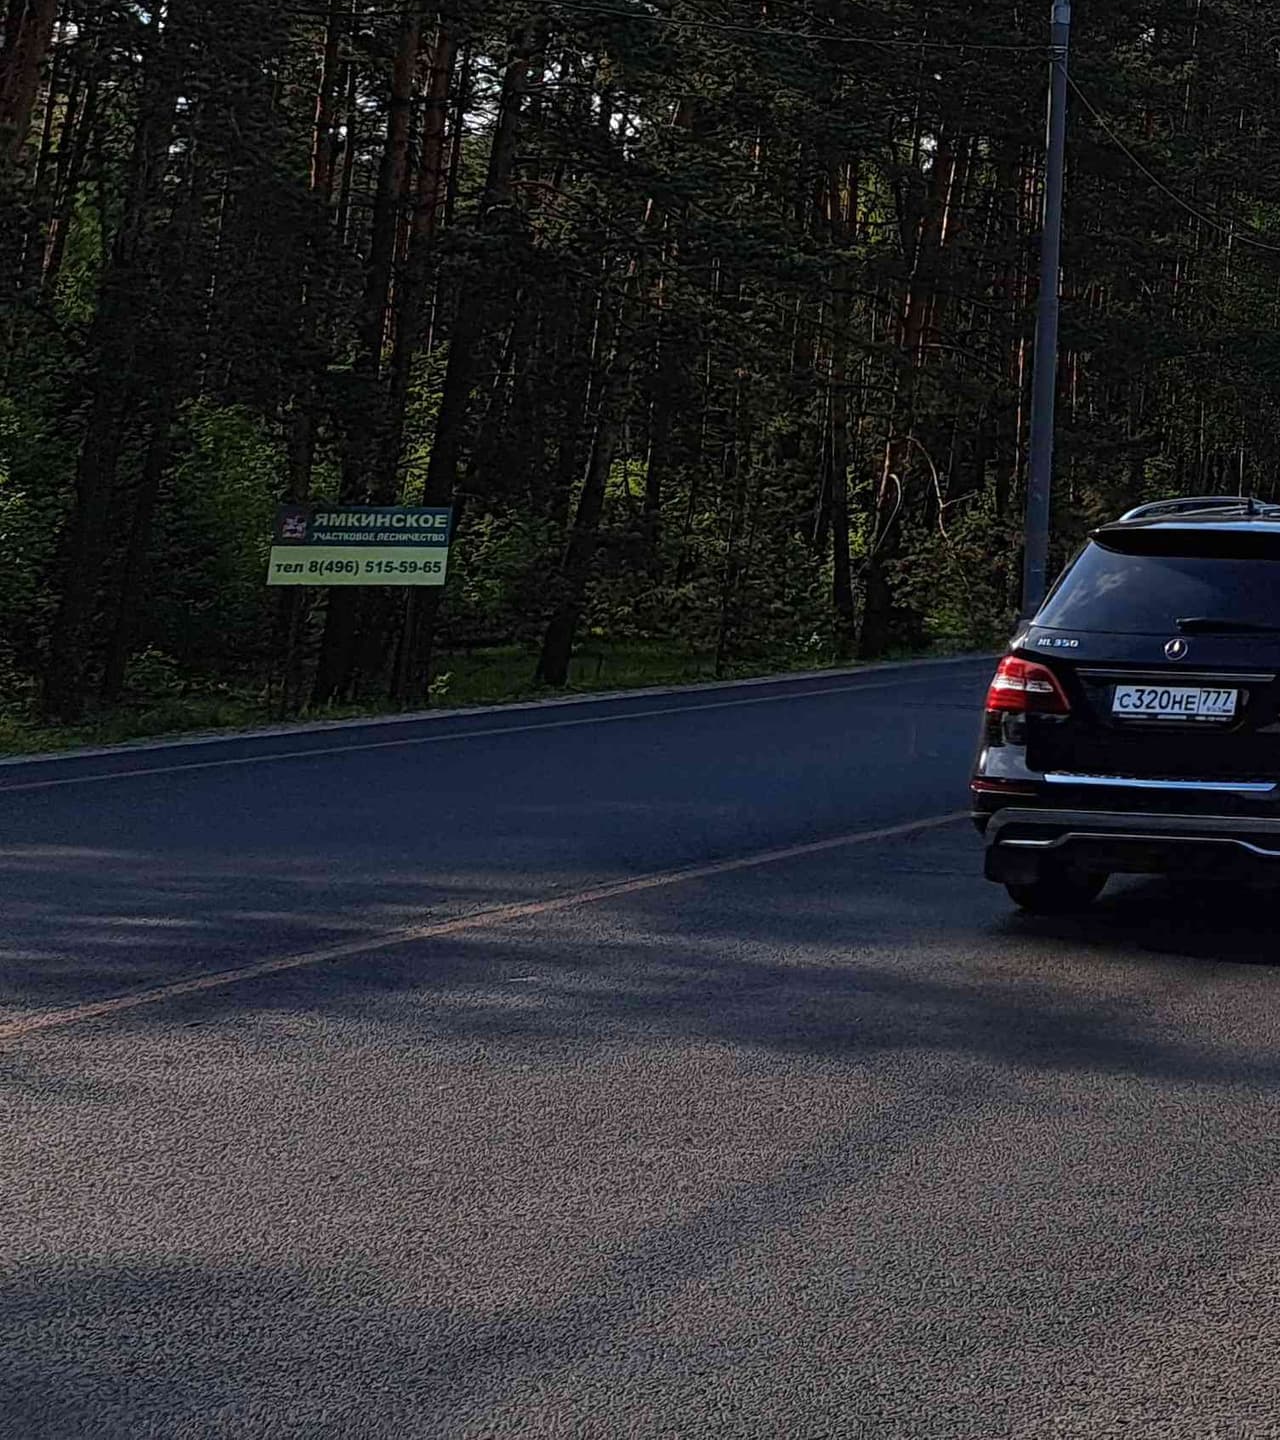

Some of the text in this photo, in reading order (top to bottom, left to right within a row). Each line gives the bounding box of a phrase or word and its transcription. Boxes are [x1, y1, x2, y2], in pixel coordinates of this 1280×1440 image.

[313, 513, 448, 528] ЯМКИНСКОЕ
[312, 532, 445, 542] УЧАСТКОВОЕ ЛЕСНИЧЕСТВО
[275, 561, 442, 576] тел 8(496) 515-59-65
